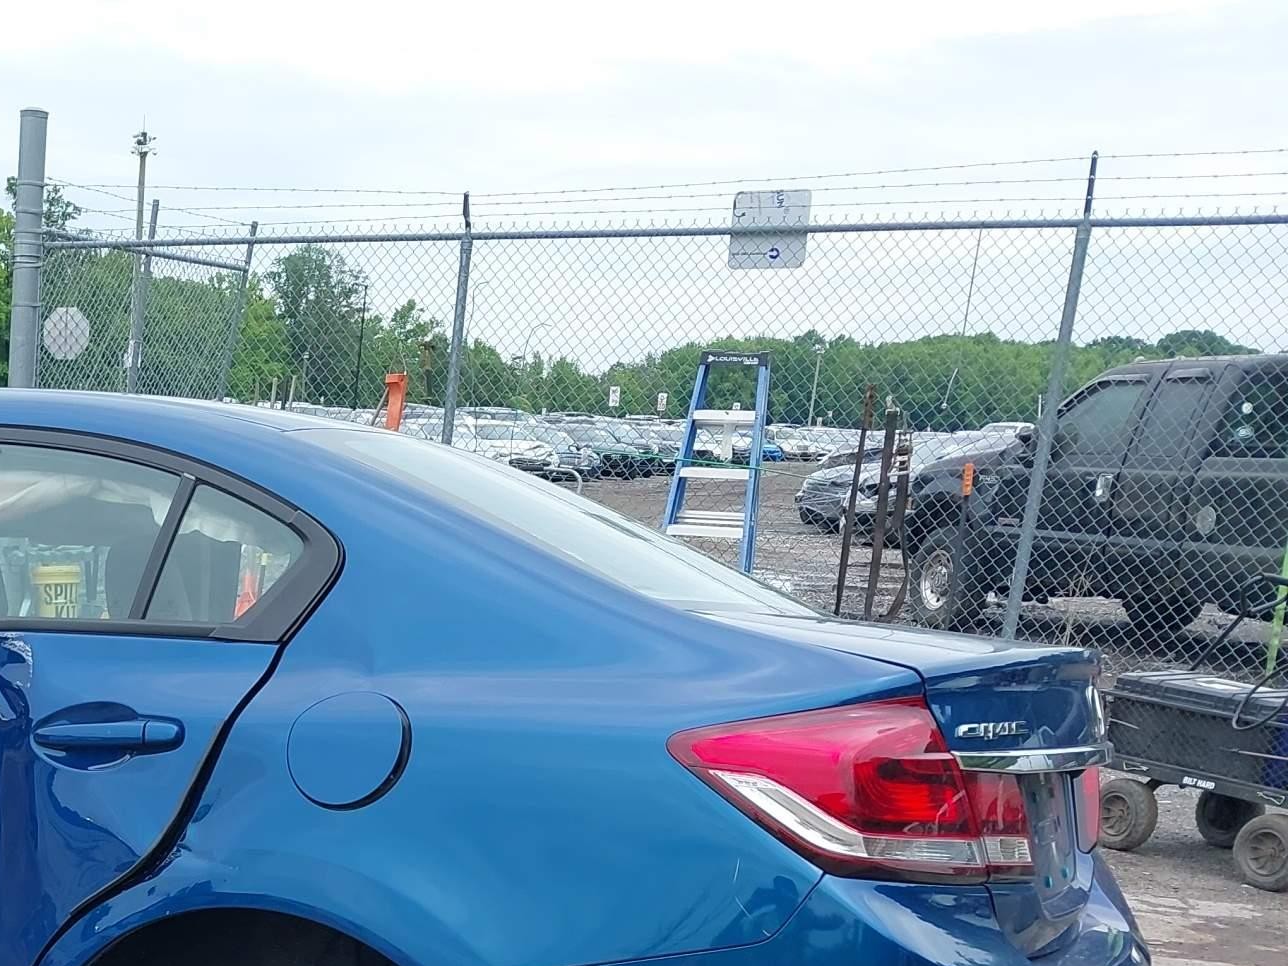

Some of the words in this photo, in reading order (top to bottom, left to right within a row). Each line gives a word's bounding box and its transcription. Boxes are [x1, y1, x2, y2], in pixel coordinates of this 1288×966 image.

[955, 721, 1029, 740] CIVIC
[1182, 776, 1197, 785] BILT
[1196, 779, 1216, 790] HARD
